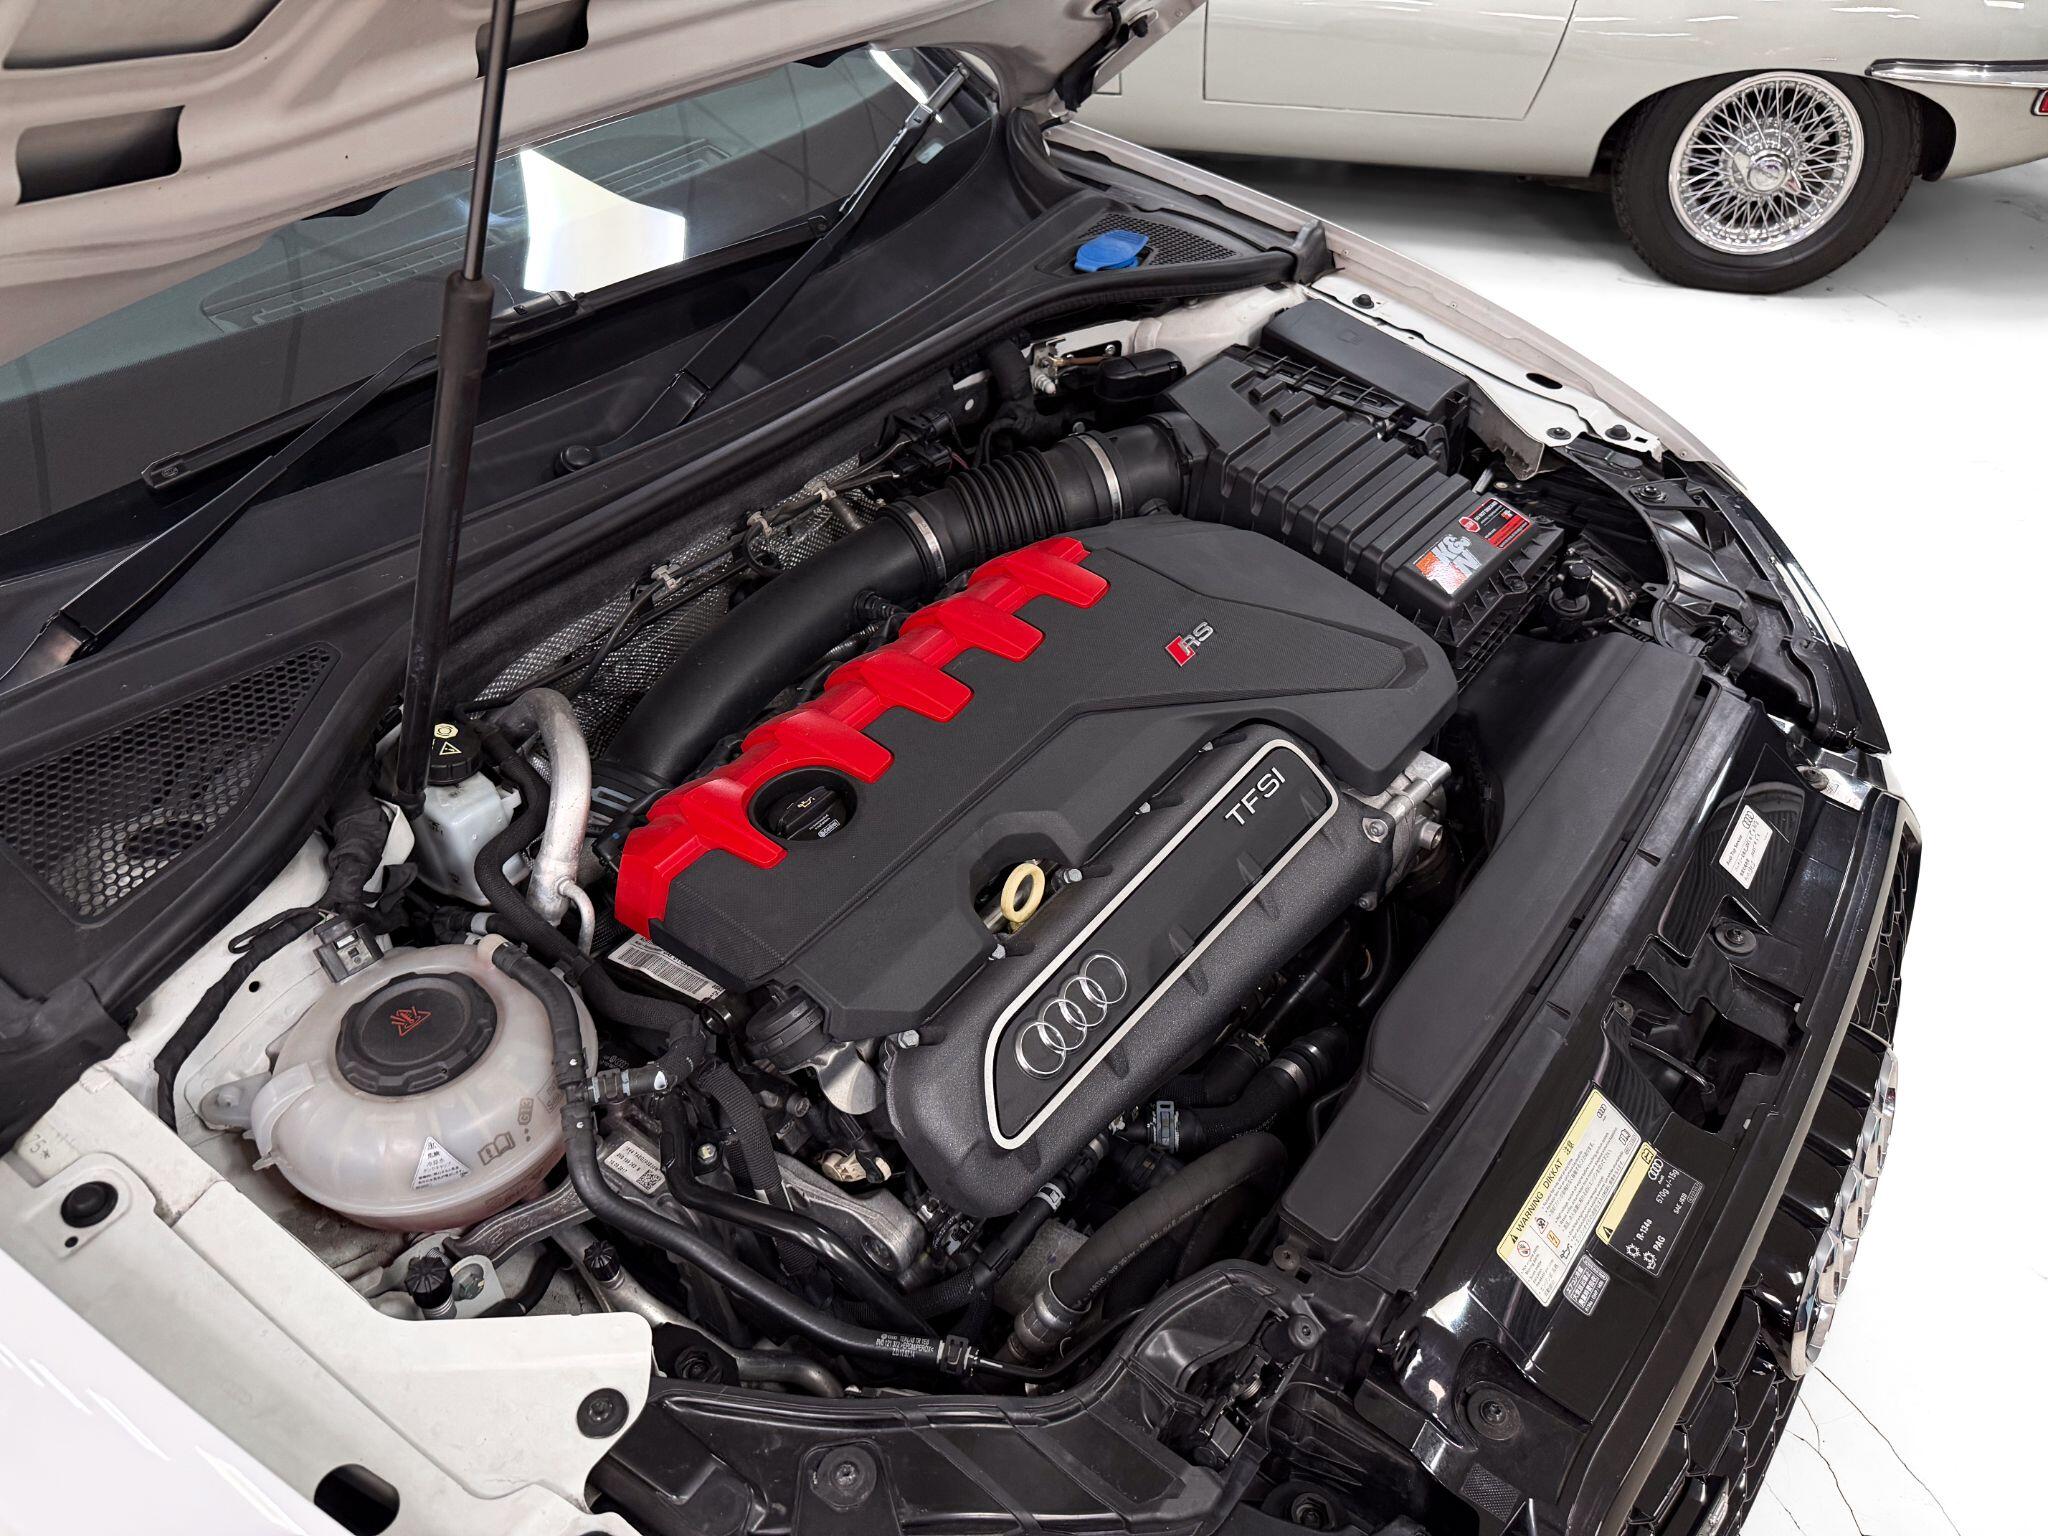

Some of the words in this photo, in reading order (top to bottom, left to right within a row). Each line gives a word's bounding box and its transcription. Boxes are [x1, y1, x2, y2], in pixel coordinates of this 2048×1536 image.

[1430, 533, 1482, 578] K&N
[1174, 621, 1214, 657] RS
[1224, 766, 1287, 826] TFSI
[520, 1101, 531, 1121] G13
[1517, 1191, 1544, 1233] WARNING
[1543, 1159, 1563, 1189] DIKKAT
[1636, 1218, 1652, 1240] R-134a
[1656, 1188, 1669, 1204] 570g
[1653, 1235, 1665, 1252] PAG
[1673, 1203, 1682, 1215] SAE
